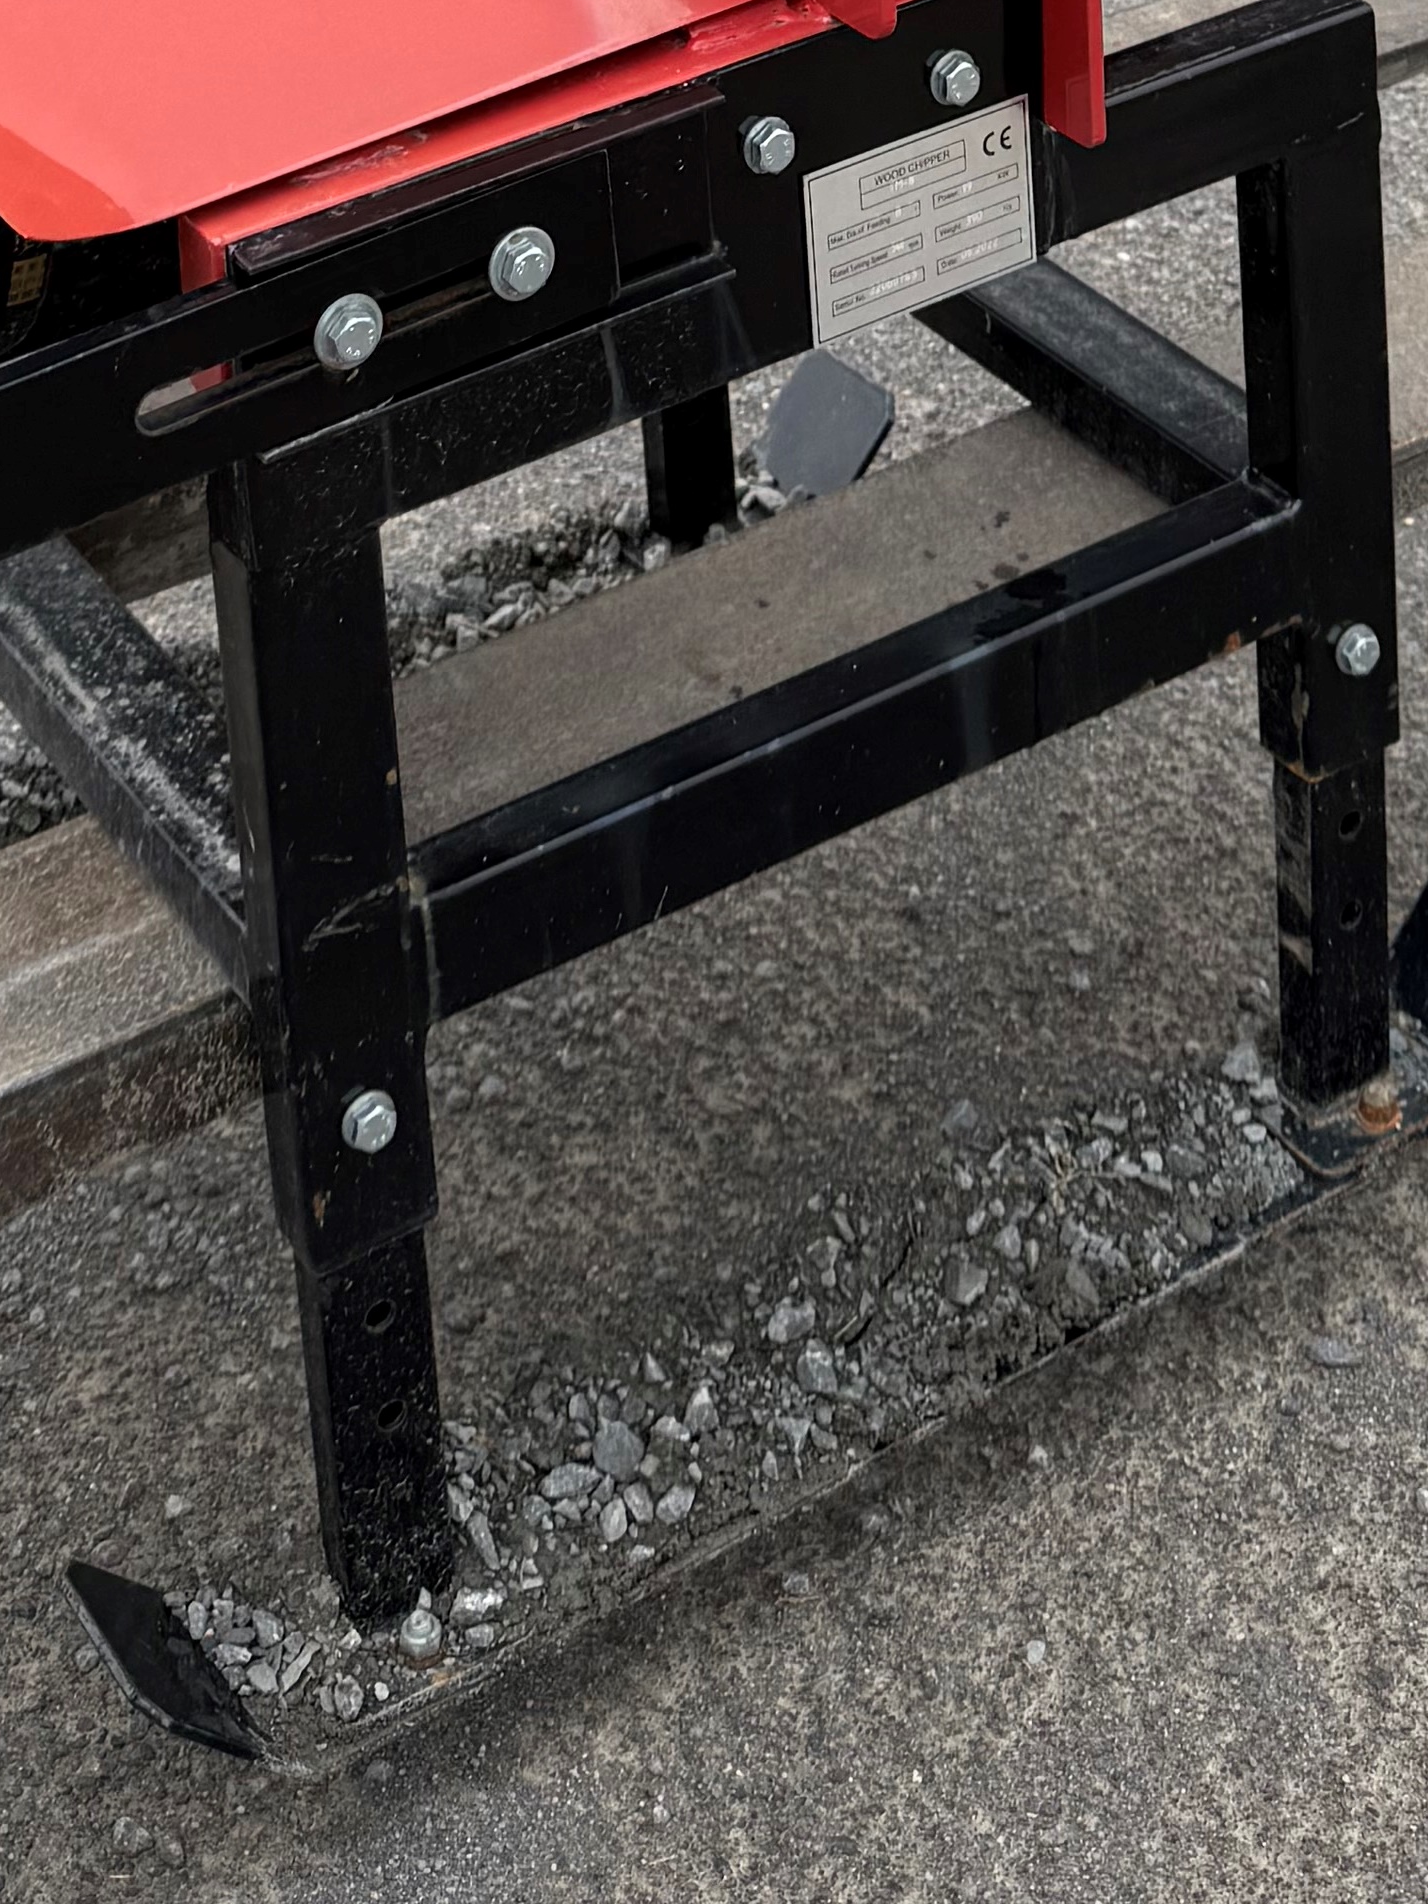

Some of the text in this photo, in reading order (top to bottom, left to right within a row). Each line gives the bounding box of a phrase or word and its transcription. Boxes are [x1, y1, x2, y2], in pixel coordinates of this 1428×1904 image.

[983, 125, 1012, 156] CE
[874, 149, 950, 185] WOOD CHIPPER
